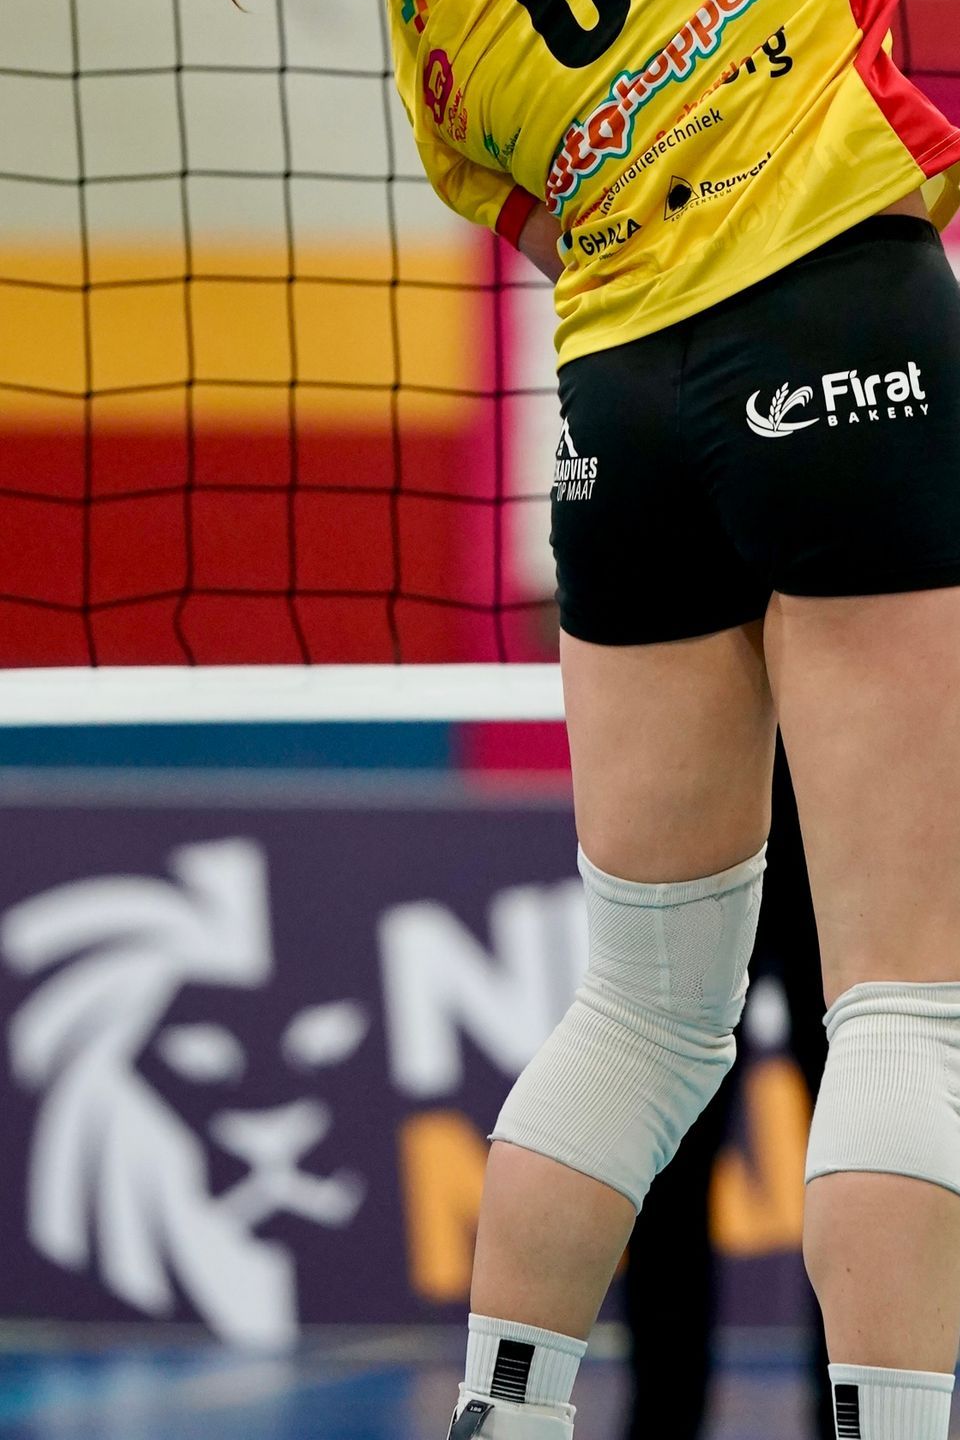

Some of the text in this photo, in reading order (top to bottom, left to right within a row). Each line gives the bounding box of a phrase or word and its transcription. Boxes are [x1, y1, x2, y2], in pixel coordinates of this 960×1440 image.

[822, 361, 926, 412] Firat
[827, 403, 929, 428] BAKERY
[566, 479, 596, 501] MAAT
